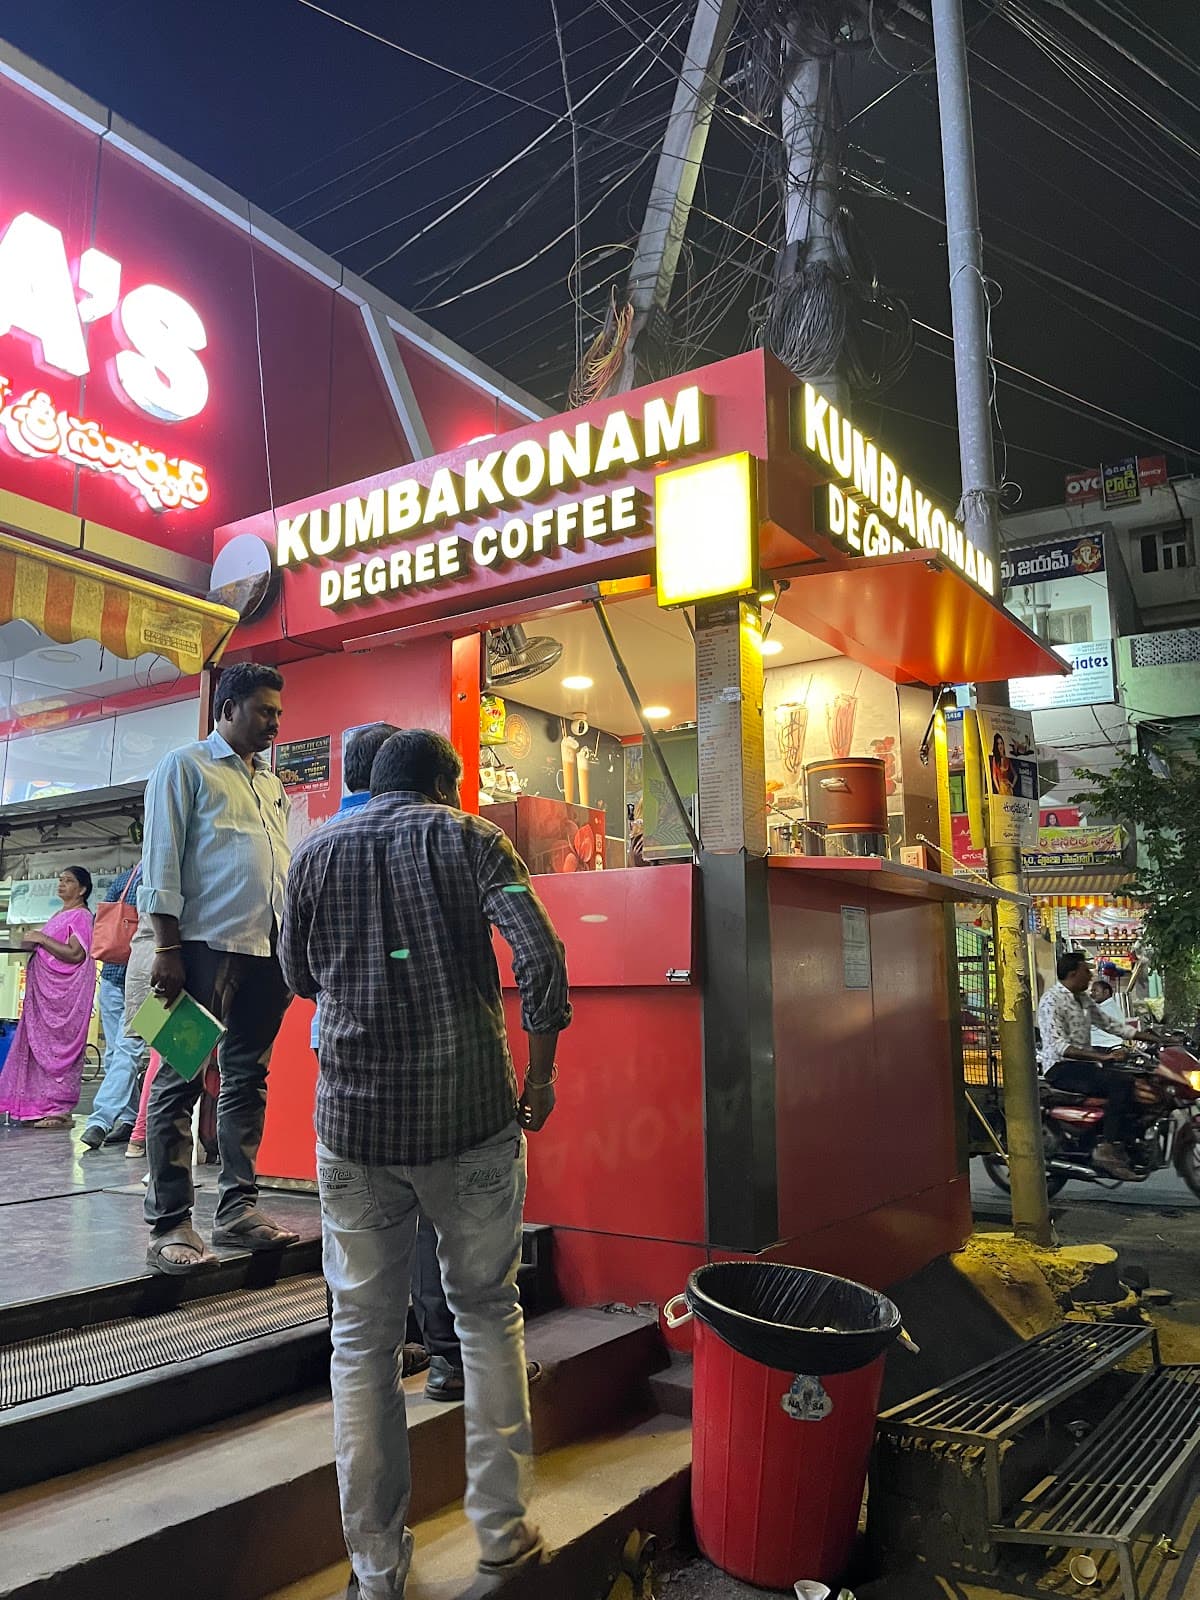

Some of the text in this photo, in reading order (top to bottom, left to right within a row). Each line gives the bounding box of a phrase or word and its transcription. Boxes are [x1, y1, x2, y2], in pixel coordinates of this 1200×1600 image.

[277, 386, 702, 566] KUMBAKONAM
[320, 486, 637, 608] DEGREE COFFEE
[804, 382, 994, 596] KUMBAKONAM
[828, 483, 911, 557] DEGR
